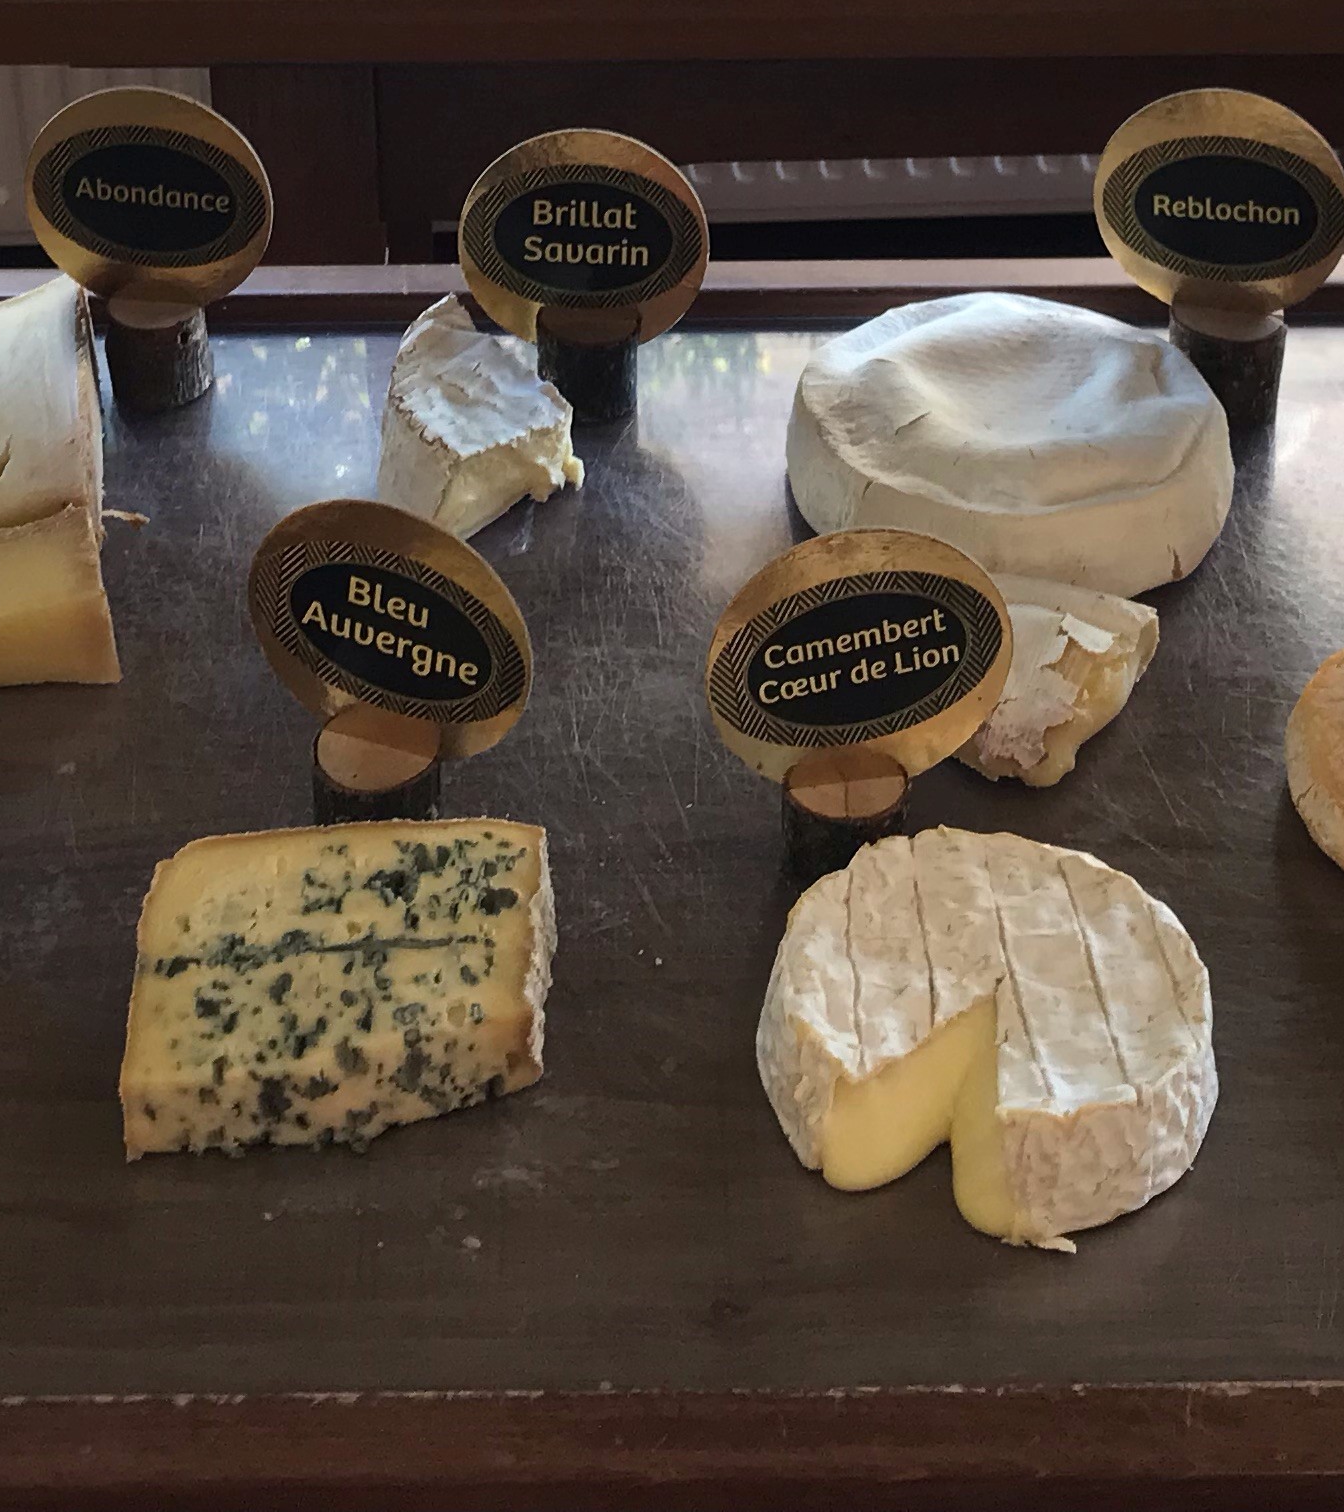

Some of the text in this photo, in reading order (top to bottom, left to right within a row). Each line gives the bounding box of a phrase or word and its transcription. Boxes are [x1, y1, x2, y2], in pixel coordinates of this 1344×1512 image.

[76, 177, 230, 214] Abondance
[533, 199, 638, 229] Brillat
[1153, 194, 1301, 225] Reblochon
[524, 237, 648, 266] Savarin
[347, 576, 430, 628] Bleu
[302, 601, 479, 685] Auvergne
[765, 609, 947, 669] Camembert
[759, 642, 960, 703] Cœur de Lion
